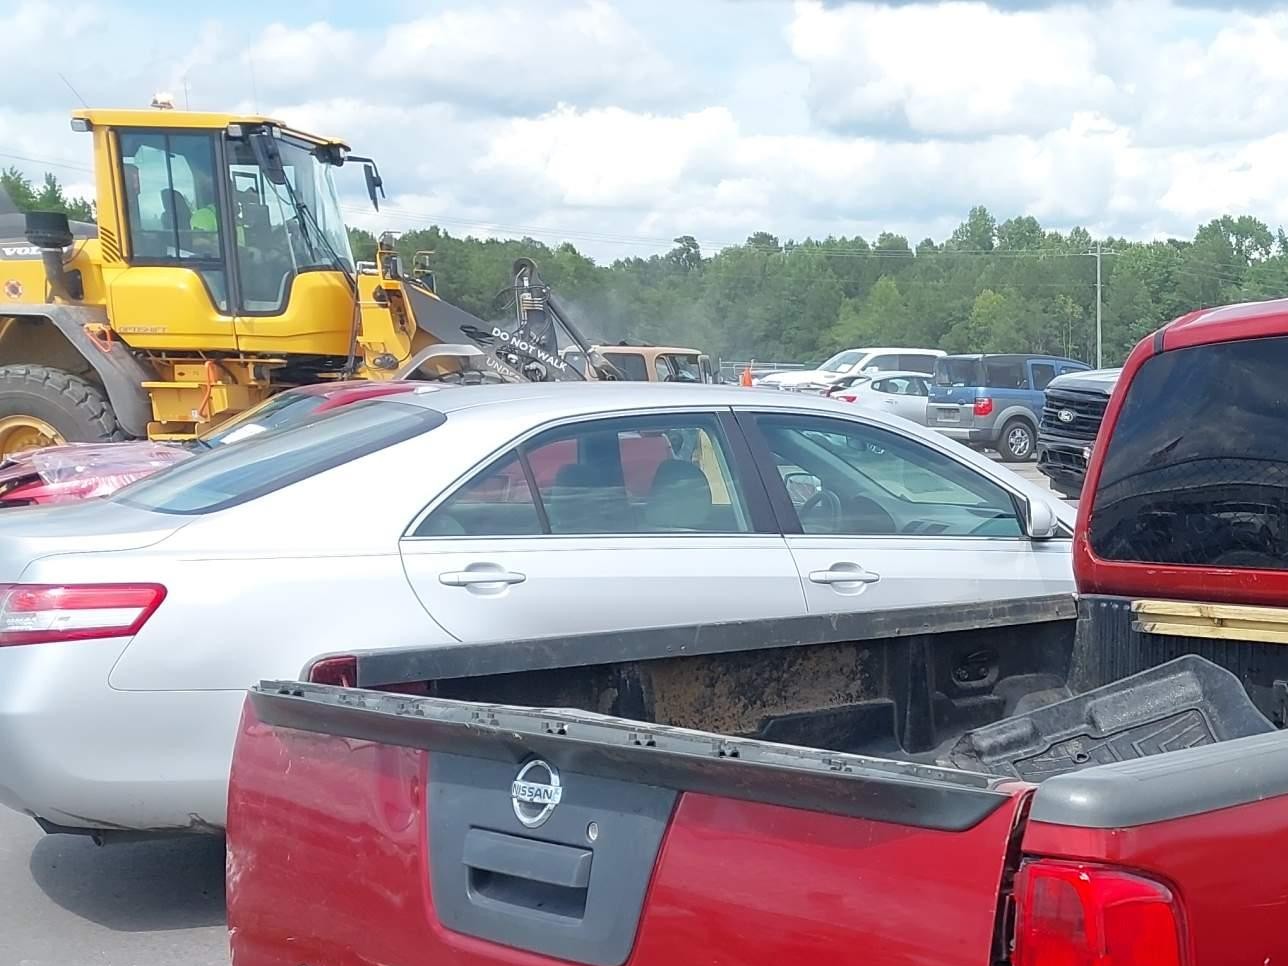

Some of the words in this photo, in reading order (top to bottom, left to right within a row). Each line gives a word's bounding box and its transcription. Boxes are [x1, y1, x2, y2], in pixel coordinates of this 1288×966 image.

[492, 327, 510, 341] DO
[510, 336, 536, 354] NOT
[537, 349, 567, 373] WALK
[512, 783, 553, 800] NISSAN
